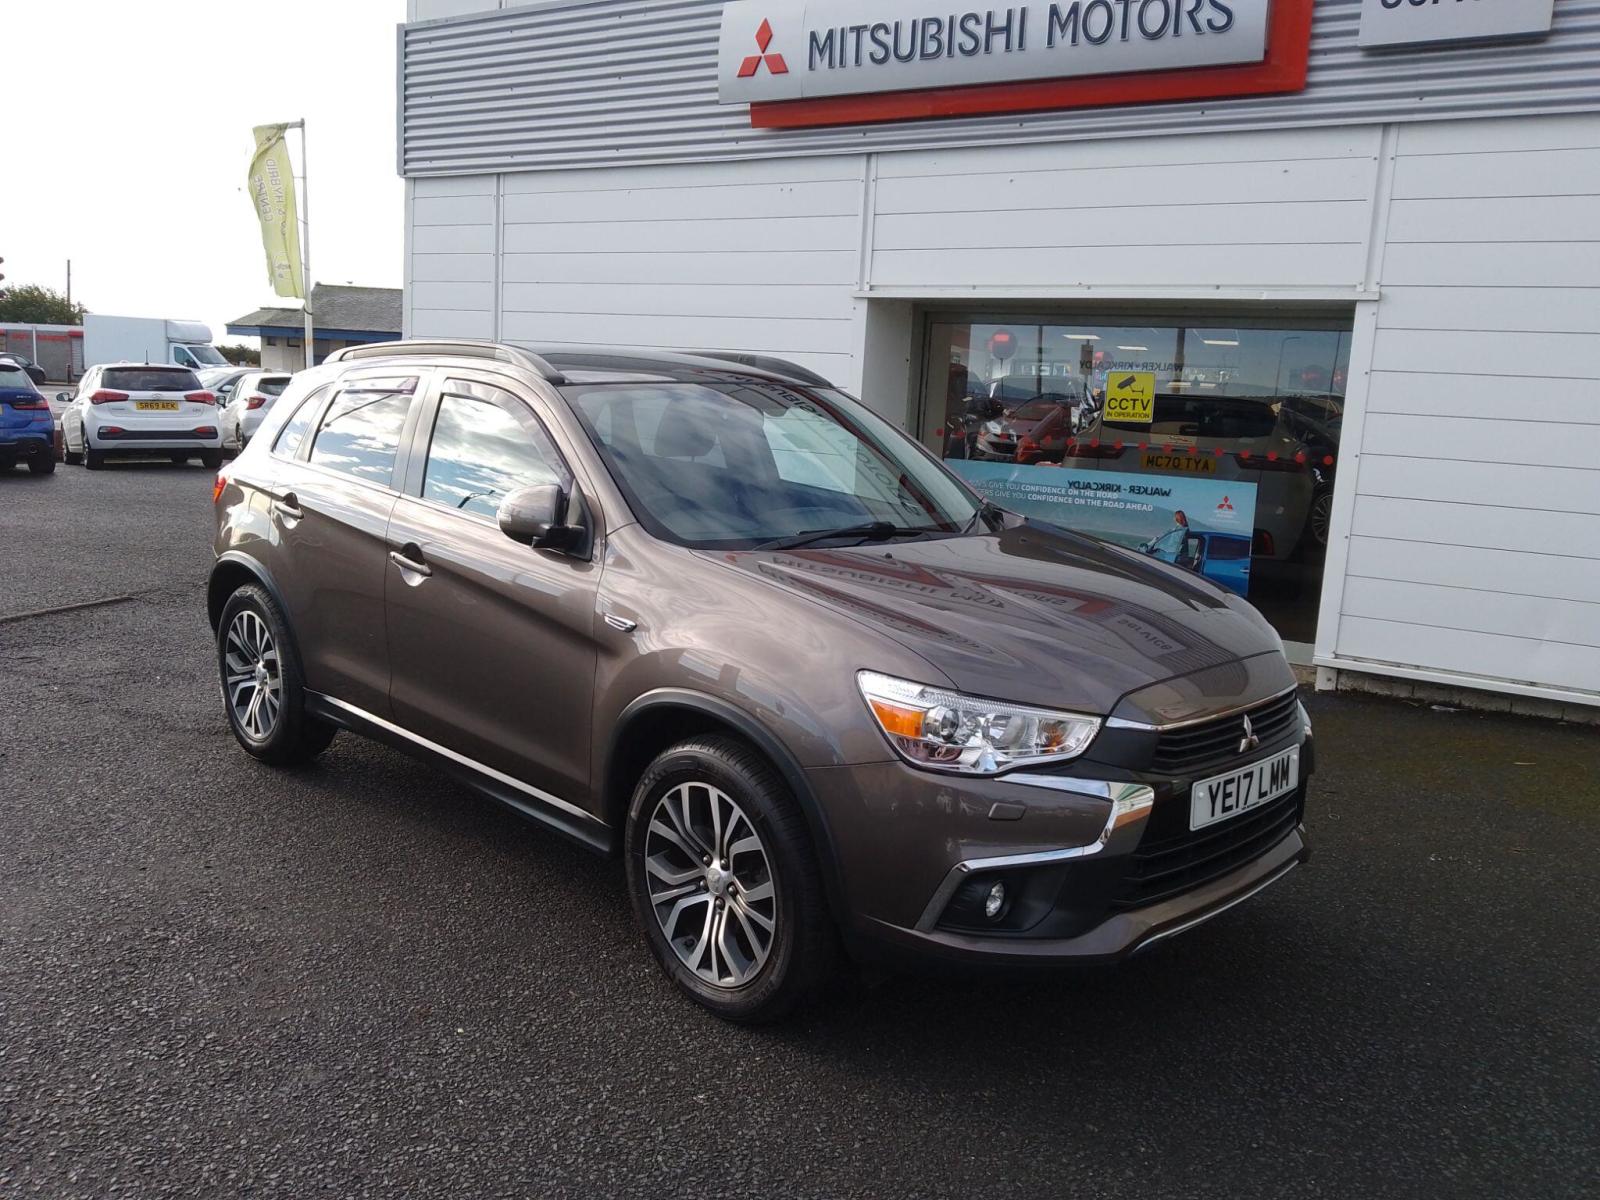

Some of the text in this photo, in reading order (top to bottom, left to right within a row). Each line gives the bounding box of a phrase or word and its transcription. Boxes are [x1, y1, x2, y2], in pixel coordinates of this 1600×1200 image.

[808, 0, 1235, 71] MITSUBISHI MOTORS
[1107, 398, 1151, 411] CCTV
[1113, 411, 1150, 419] OPERATION
[1146, 455, 1209, 471] MC70 TYA
[1006, 482, 1020, 490] YOU
[1021, 484, 1066, 495] CONFIDENCE
[1080, 489, 1095, 497] THE
[1096, 490, 1119, 499] ROAD
[994, 489, 1011, 498] GIVE
[1011, 491, 1027, 499] YOU
[1027, 493, 1073, 504] CONFIDENCE
[1086, 499, 1102, 507] THE
[1102, 501, 1125, 509] ROAD
[1125, 502, 1154, 512] AHEAD
[1208, 754, 1290, 818] YE17 LMM
